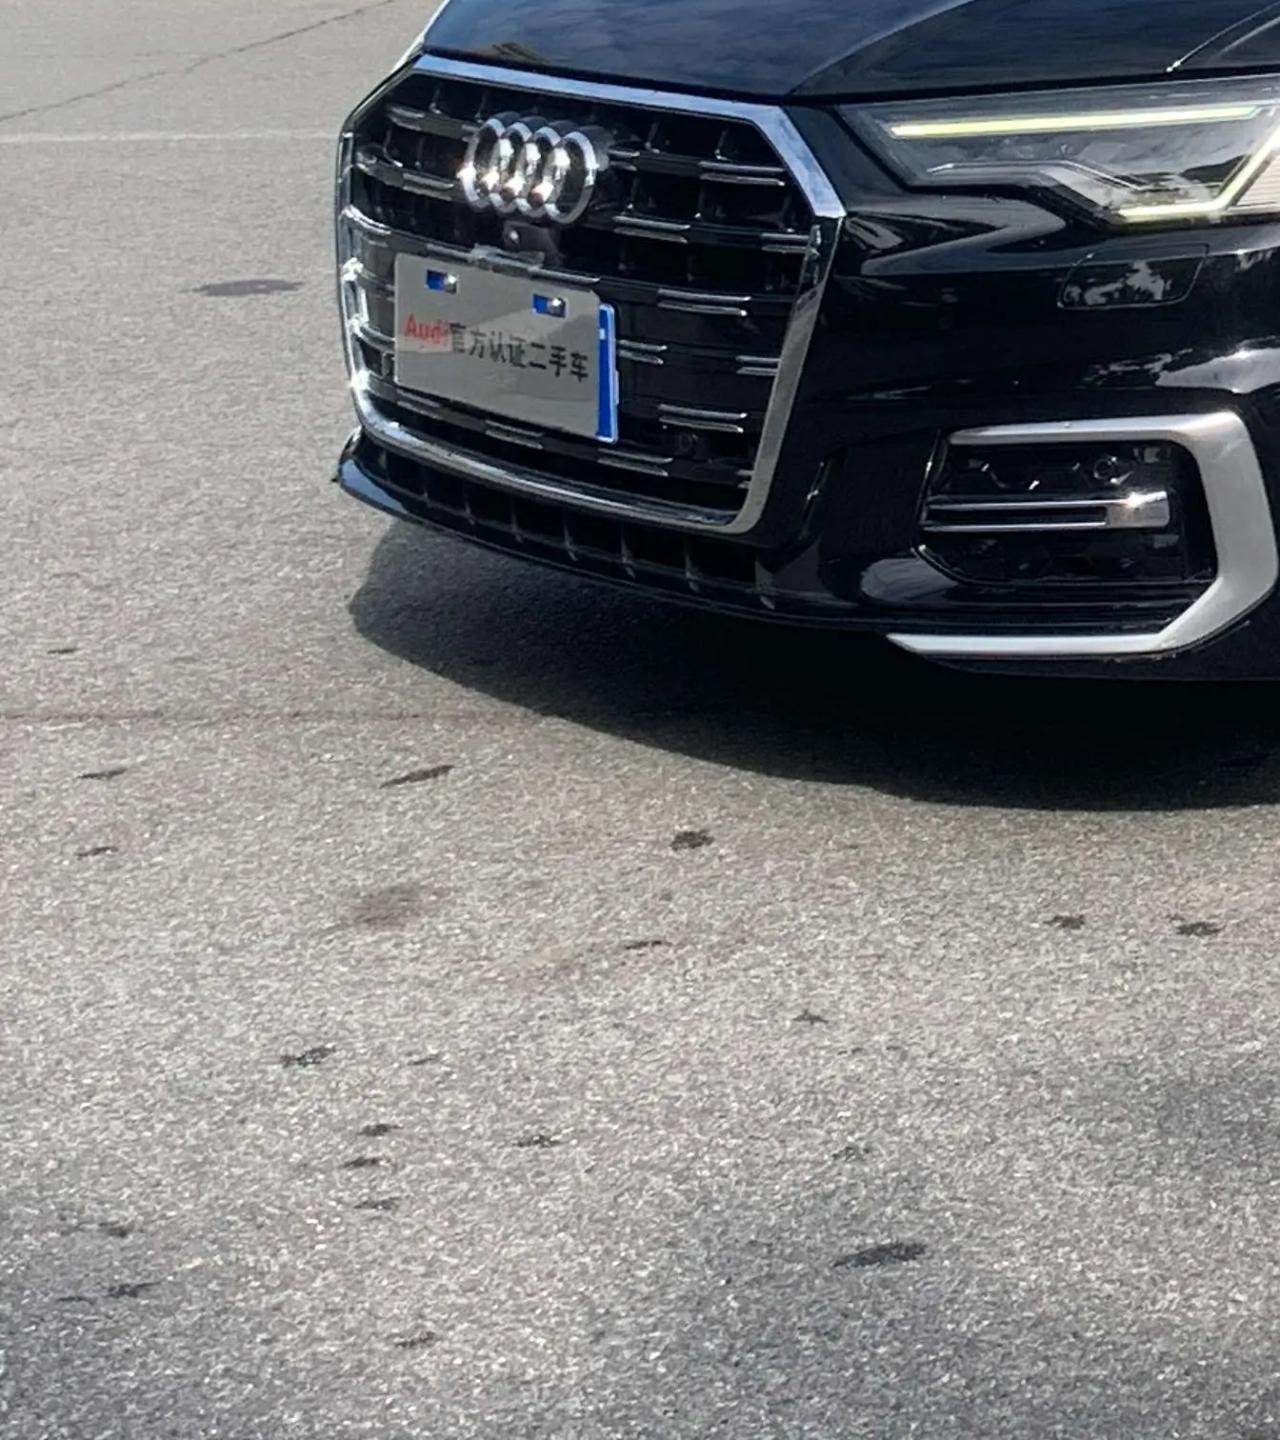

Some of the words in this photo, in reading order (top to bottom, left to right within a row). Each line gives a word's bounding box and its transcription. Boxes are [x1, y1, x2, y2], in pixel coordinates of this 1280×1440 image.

[404, 314, 450, 345] Audi
[450, 322, 589, 382] 官方认证二手车
